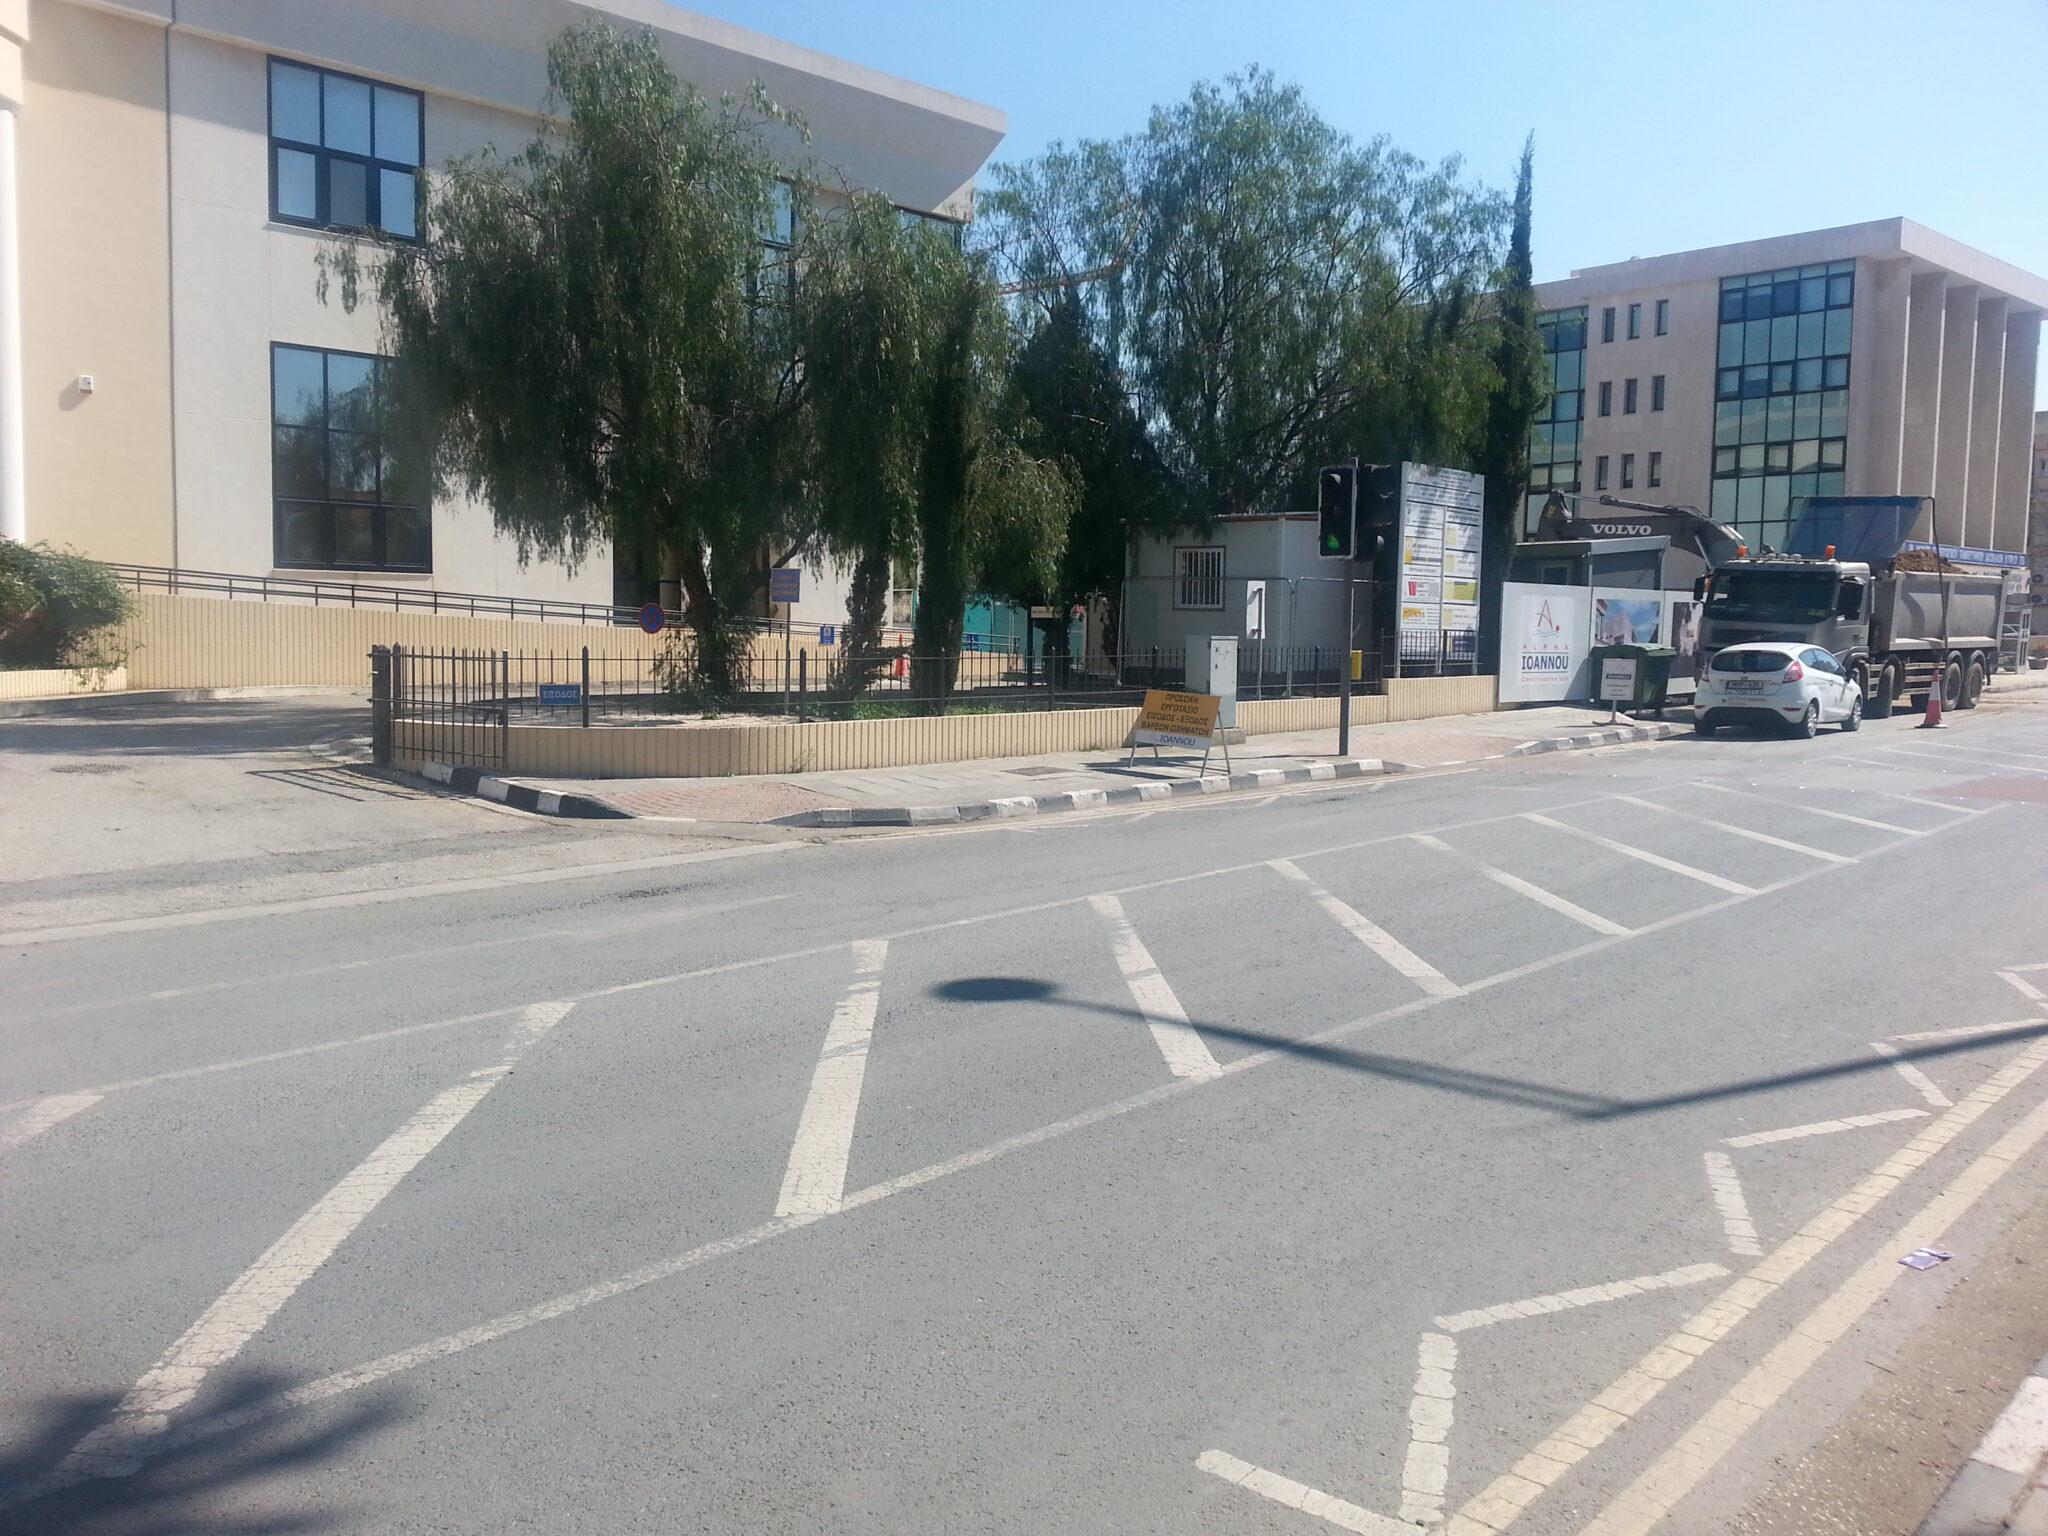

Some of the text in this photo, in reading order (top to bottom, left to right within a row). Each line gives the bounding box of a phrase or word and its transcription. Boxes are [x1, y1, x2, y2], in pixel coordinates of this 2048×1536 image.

[1590, 524, 1652, 535] VOLVO
[1521, 655, 1569, 670] IOANNOU
[543, 690, 577, 698] ΕΙΣΟΔΟΣ
[1166, 694, 1199, 704] ΠΡΟΣΟΧΗ
[1161, 704, 1199, 713] ΕΡΓΟΤΑΞΙΟ
[1147, 712, 1175, 721] ΕΙΣΟΔΟΣ
[1180, 716, 1208, 725] ΕΞΟΔΟΣ
[1160, 735, 1196, 745] IOANNOU
